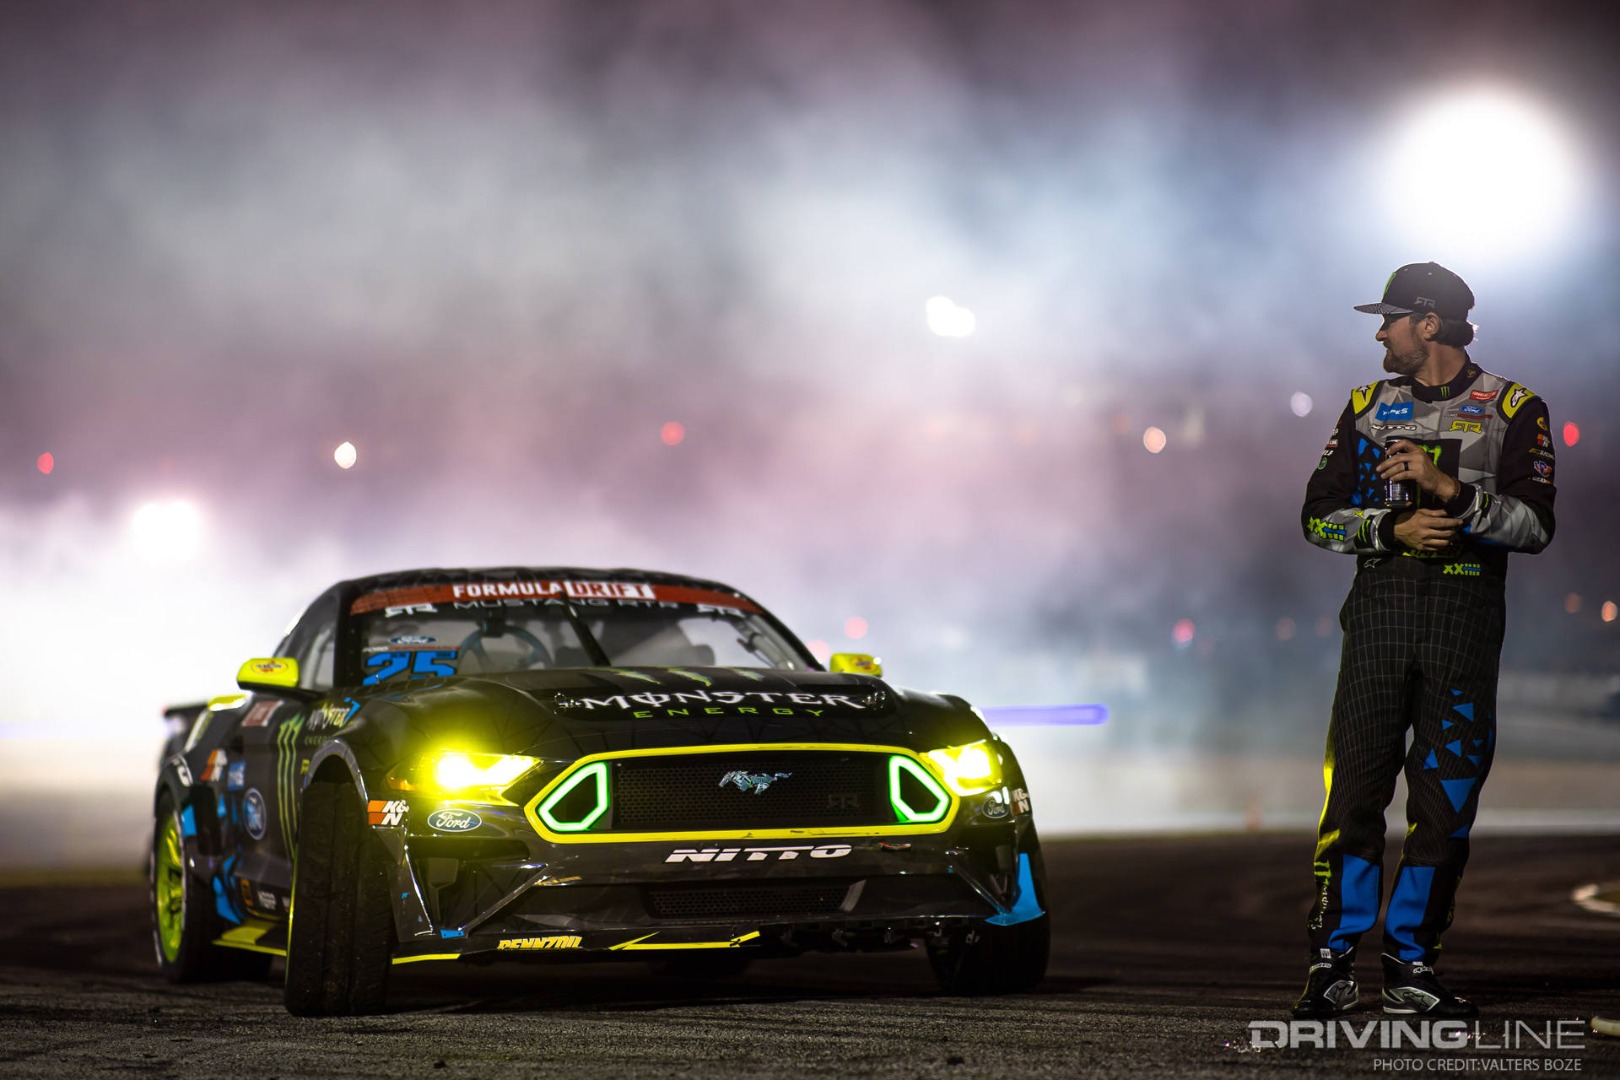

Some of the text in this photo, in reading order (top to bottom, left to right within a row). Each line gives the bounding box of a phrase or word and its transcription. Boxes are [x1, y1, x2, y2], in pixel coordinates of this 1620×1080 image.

[452, 581, 655, 599] FORMULA DRIFT
[362, 650, 458, 686] 25
[579, 689, 865, 710] MONSTER
[632, 706, 825, 719] ENERGY
[664, 844, 853, 863] NITTO
